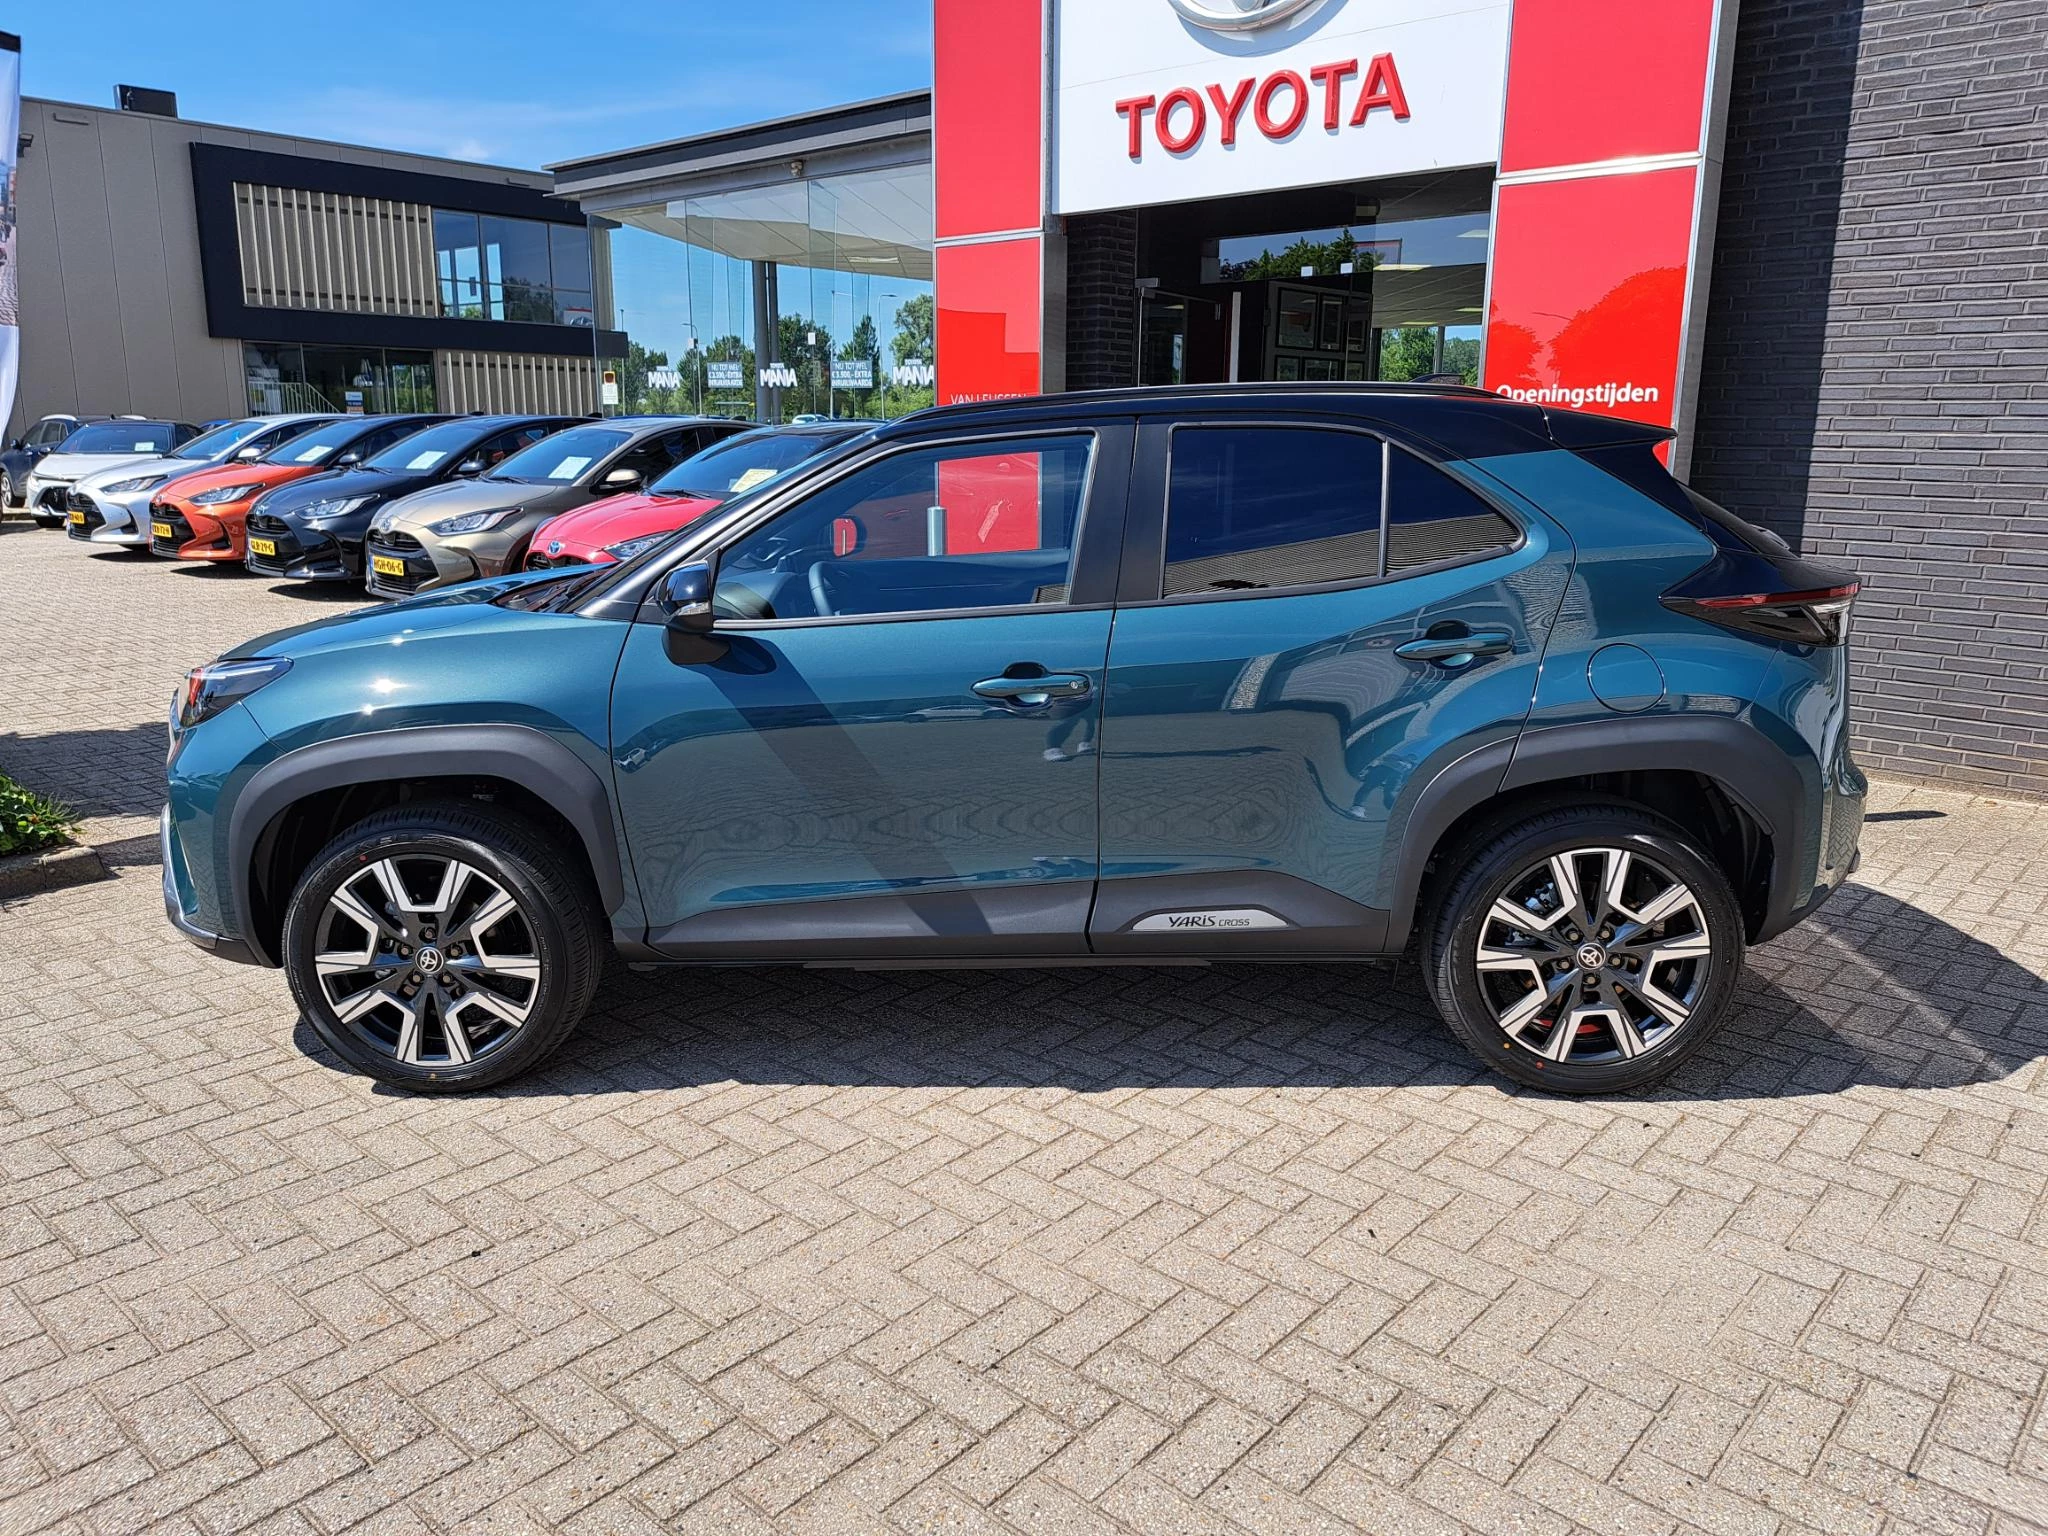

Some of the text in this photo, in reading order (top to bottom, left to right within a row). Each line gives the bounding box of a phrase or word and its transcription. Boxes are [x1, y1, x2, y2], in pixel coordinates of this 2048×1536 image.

[1115, 52, 1410, 158] TOYOTA
[648, 371, 681, 388] MANIA
[760, 368, 798, 388] MANIA
[892, 365, 934, 386] MANIA
[950, 393, 973, 405] VAN
[1496, 382, 1659, 408] Openingstijden
[1218, 918, 1251, 927] CROSS
